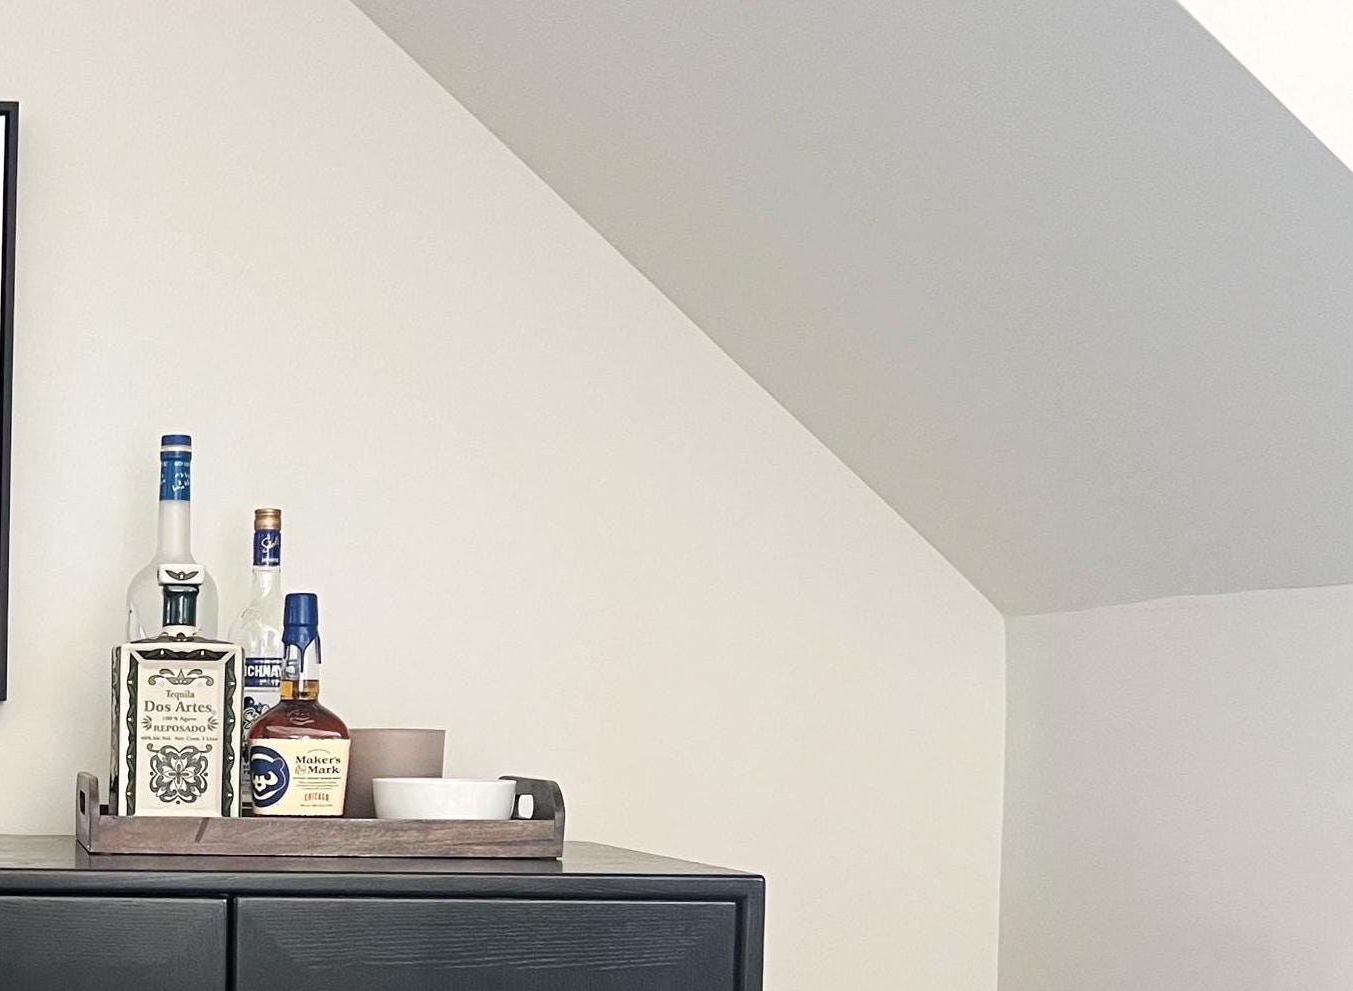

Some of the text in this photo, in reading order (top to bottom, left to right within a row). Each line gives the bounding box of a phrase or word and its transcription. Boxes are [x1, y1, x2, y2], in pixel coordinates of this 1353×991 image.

[166, 689, 195, 702] Tequila
[144, 700, 213, 713] Dos Artes
[153, 724, 206, 733] REPOSADO
[295, 755, 342, 764] Maker's
[307, 765, 341, 774] Mark
